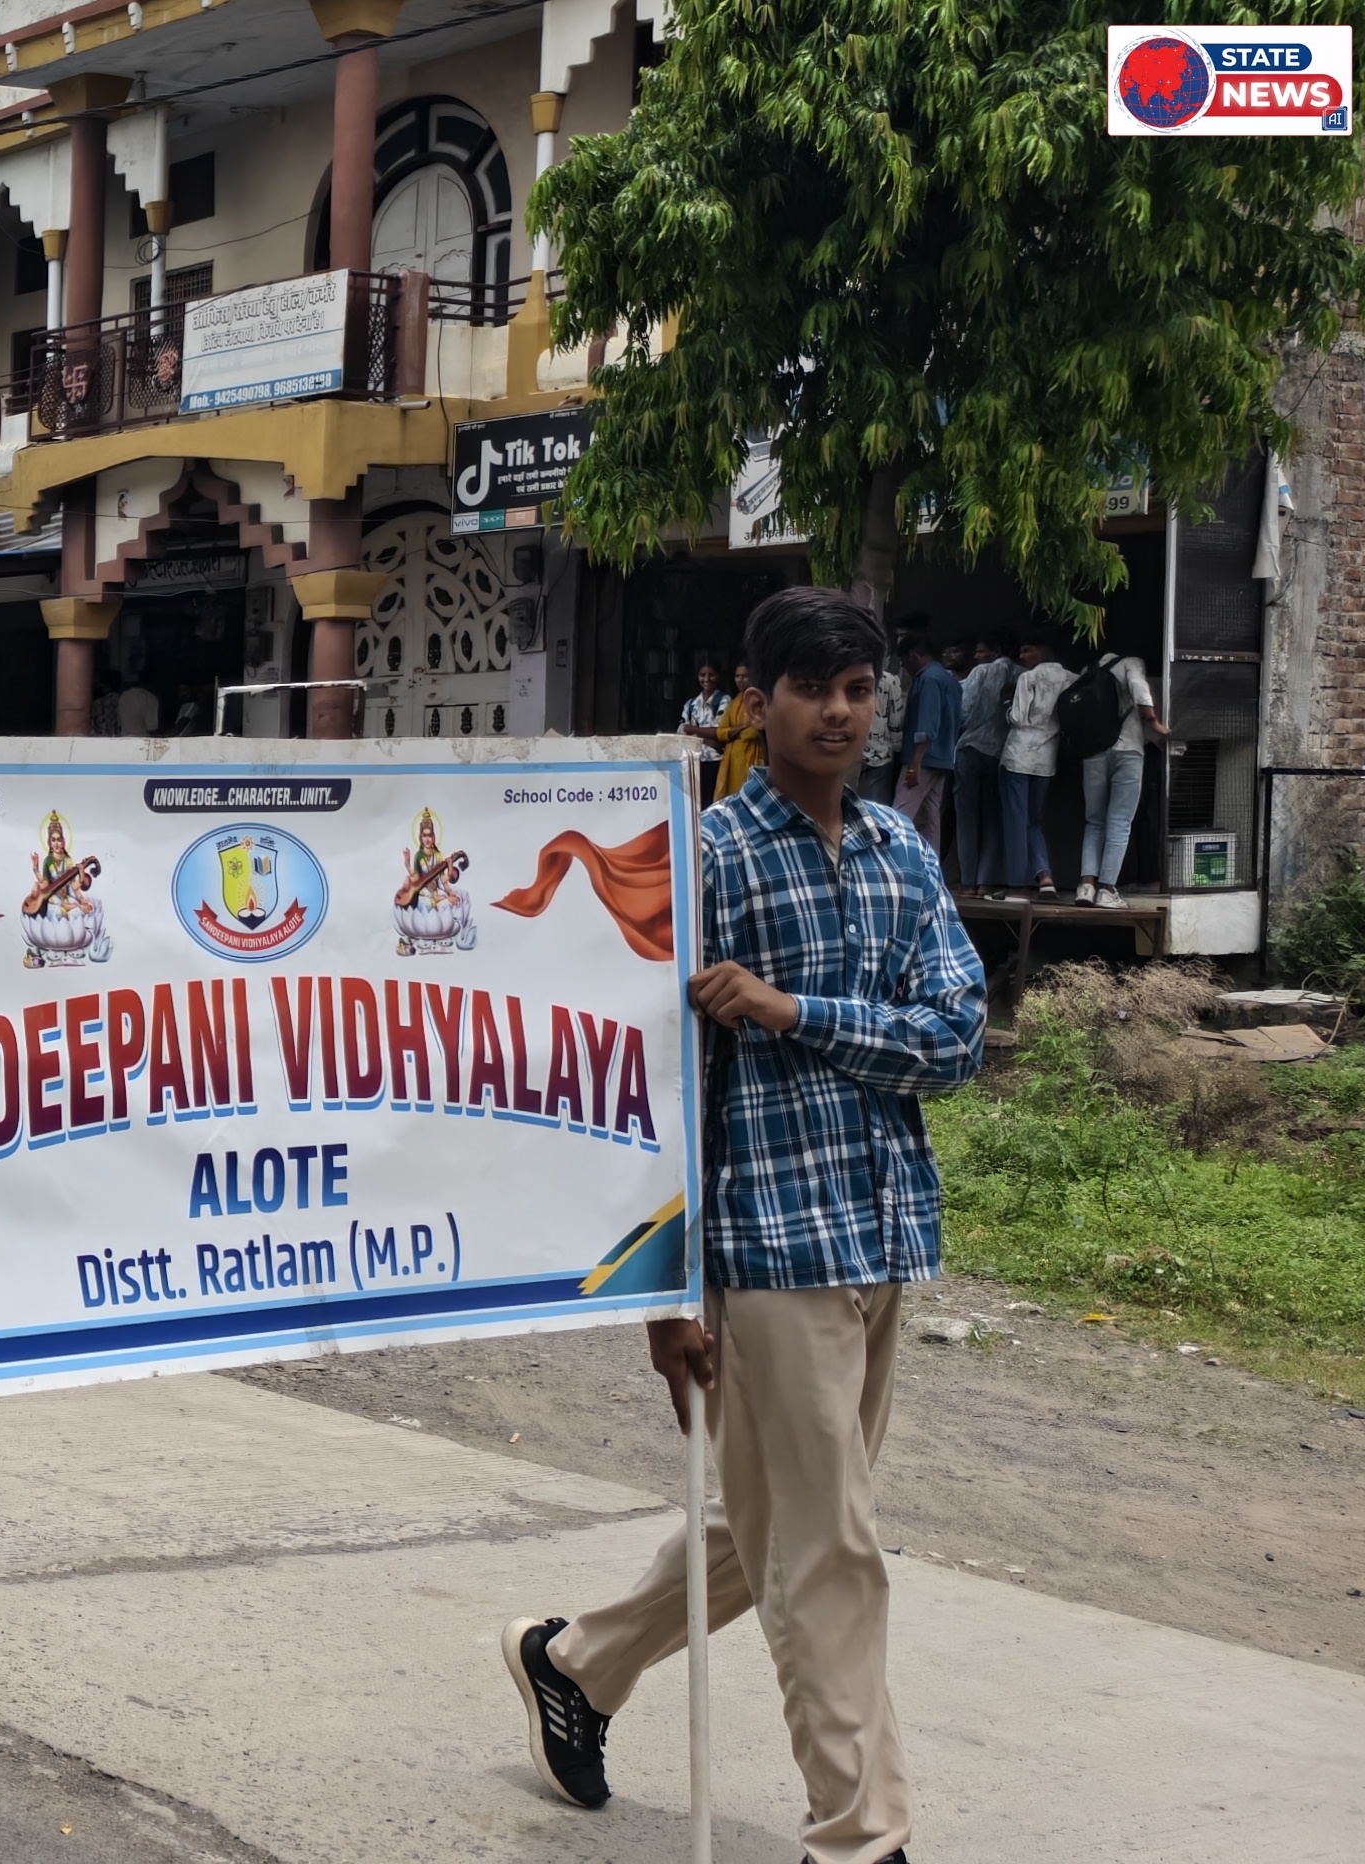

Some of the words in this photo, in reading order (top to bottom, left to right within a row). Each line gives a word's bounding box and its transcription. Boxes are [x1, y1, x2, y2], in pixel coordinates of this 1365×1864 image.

[505, 438, 535, 467] Tik
[542, 434, 580, 462] Tok
[454, 518, 479, 529] vivo
[504, 788, 551, 804] School
[557, 788, 594, 803] Code
[599, 790, 603, 802] :
[607, 786, 657, 801] 431020
[200, 916, 241, 948] SANDEEPANI
[241, 930, 283, 948] VIDHYALAYA
[282, 913, 302, 937] ALOTE
[268, 976, 660, 1153] VIDHYALAYA
[189, 1143, 348, 1219] ALOTE
[76, 1248, 187, 1308] Distt.
[196, 1233, 336, 1296] Ratlam
[349, 1212, 461, 1291] (M.P.)
